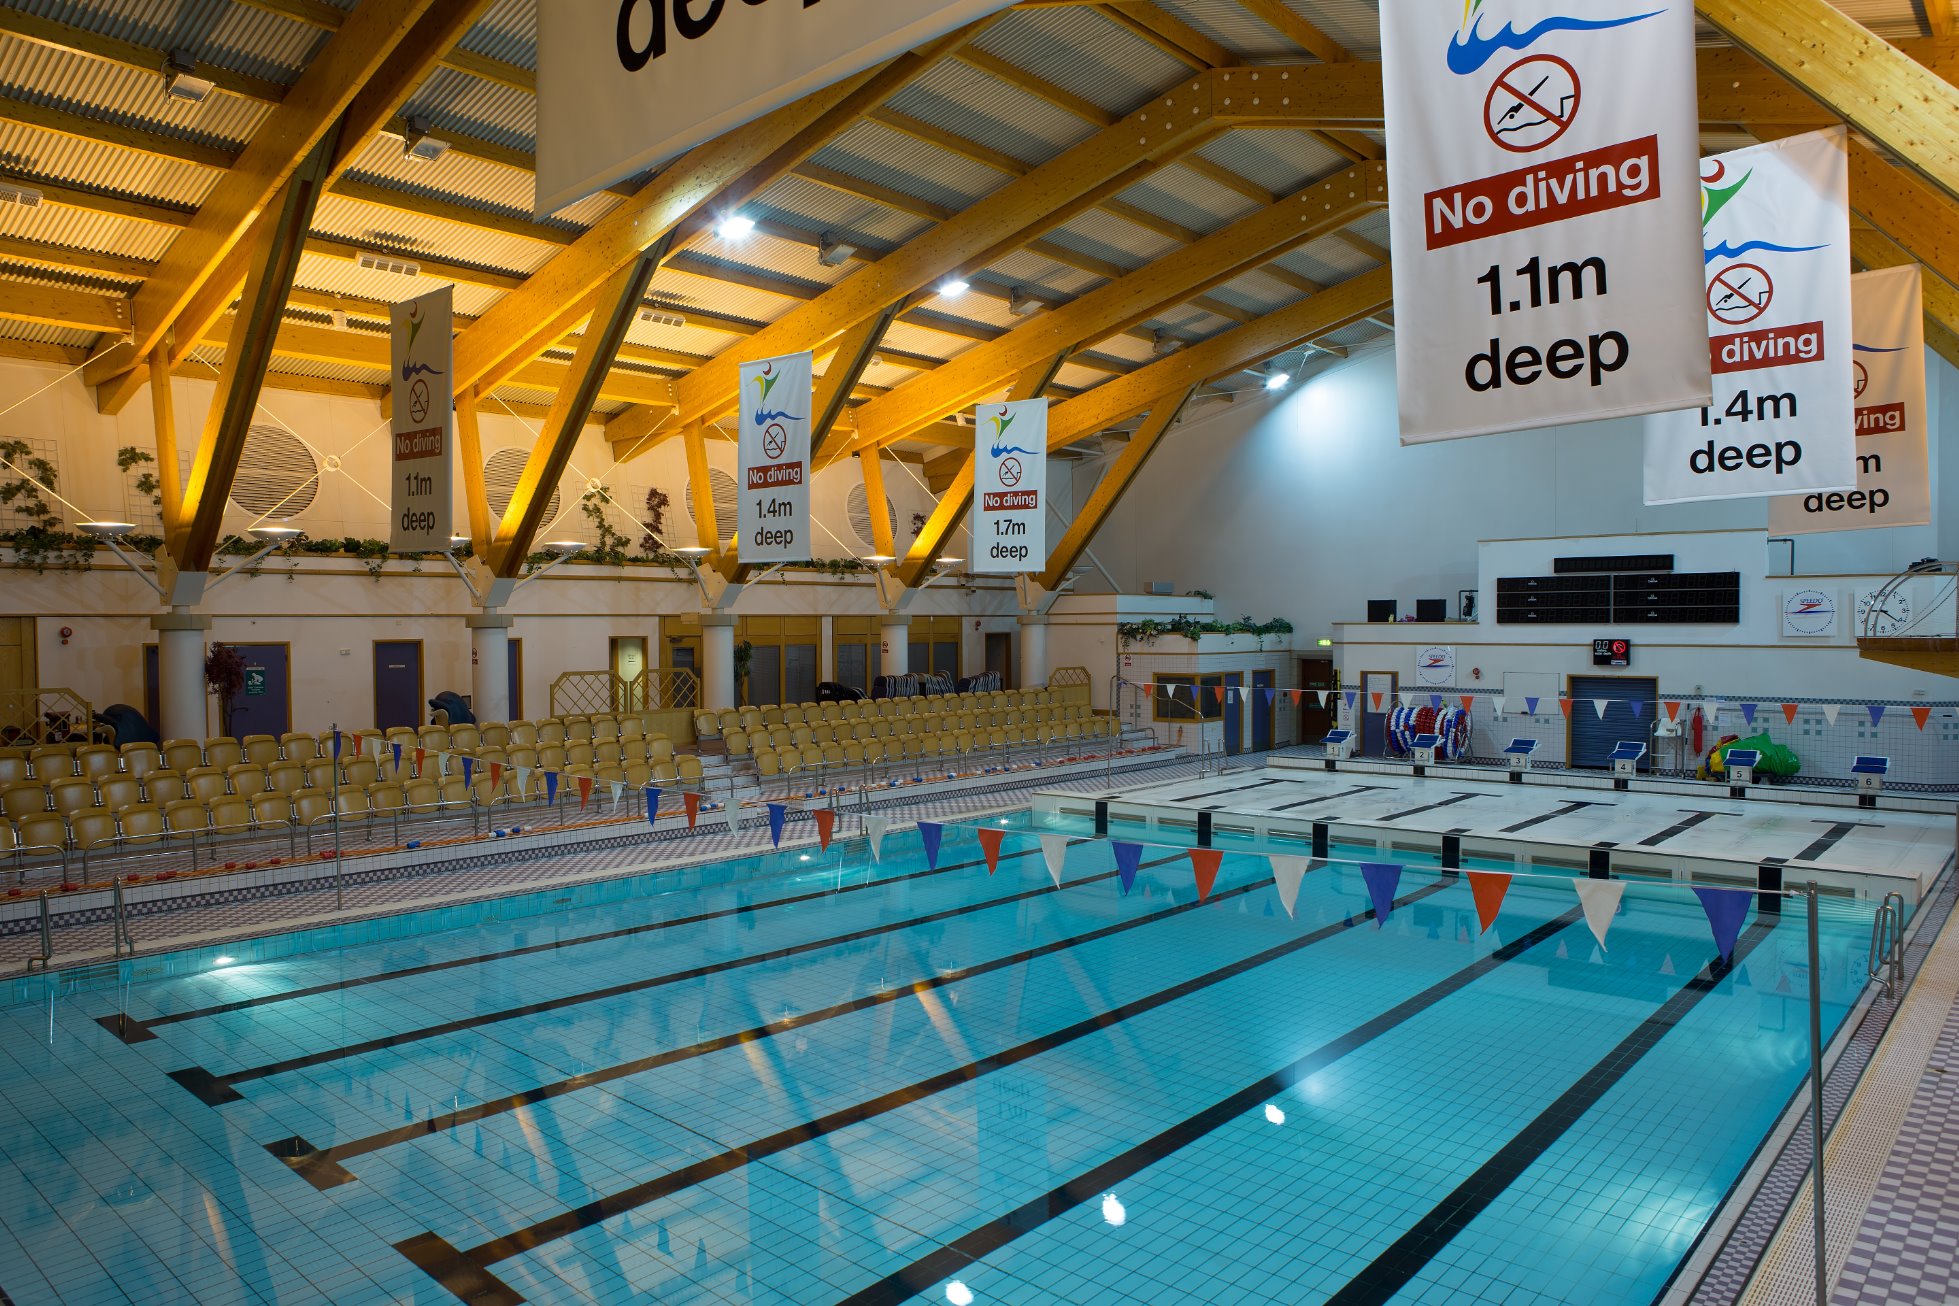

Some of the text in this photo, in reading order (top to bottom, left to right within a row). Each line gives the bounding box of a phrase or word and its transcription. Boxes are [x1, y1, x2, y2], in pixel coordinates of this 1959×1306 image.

[1432, 155, 1650, 234] No diving
[1477, 256, 1607, 315] 1.1m
[1721, 332, 1818, 364] diving
[1465, 330, 1629, 392] deep
[397, 432, 441, 455] No diving
[1690, 440, 1802, 474] deep
[405, 472, 432, 497] 1.1m
[749, 466, 800, 485] No diving
[756, 498, 792, 518] 1.4m
[985, 493, 1036, 507] No diving
[1803, 488, 1889, 513] deep
[402, 507, 435, 535] deep
[993, 519, 1026, 535] 1.7m
[754, 526, 793, 549] deep
[990, 542, 1028, 561] deep
[1737, 770, 1743, 778] 5
[1866, 778, 1872, 786] 6
